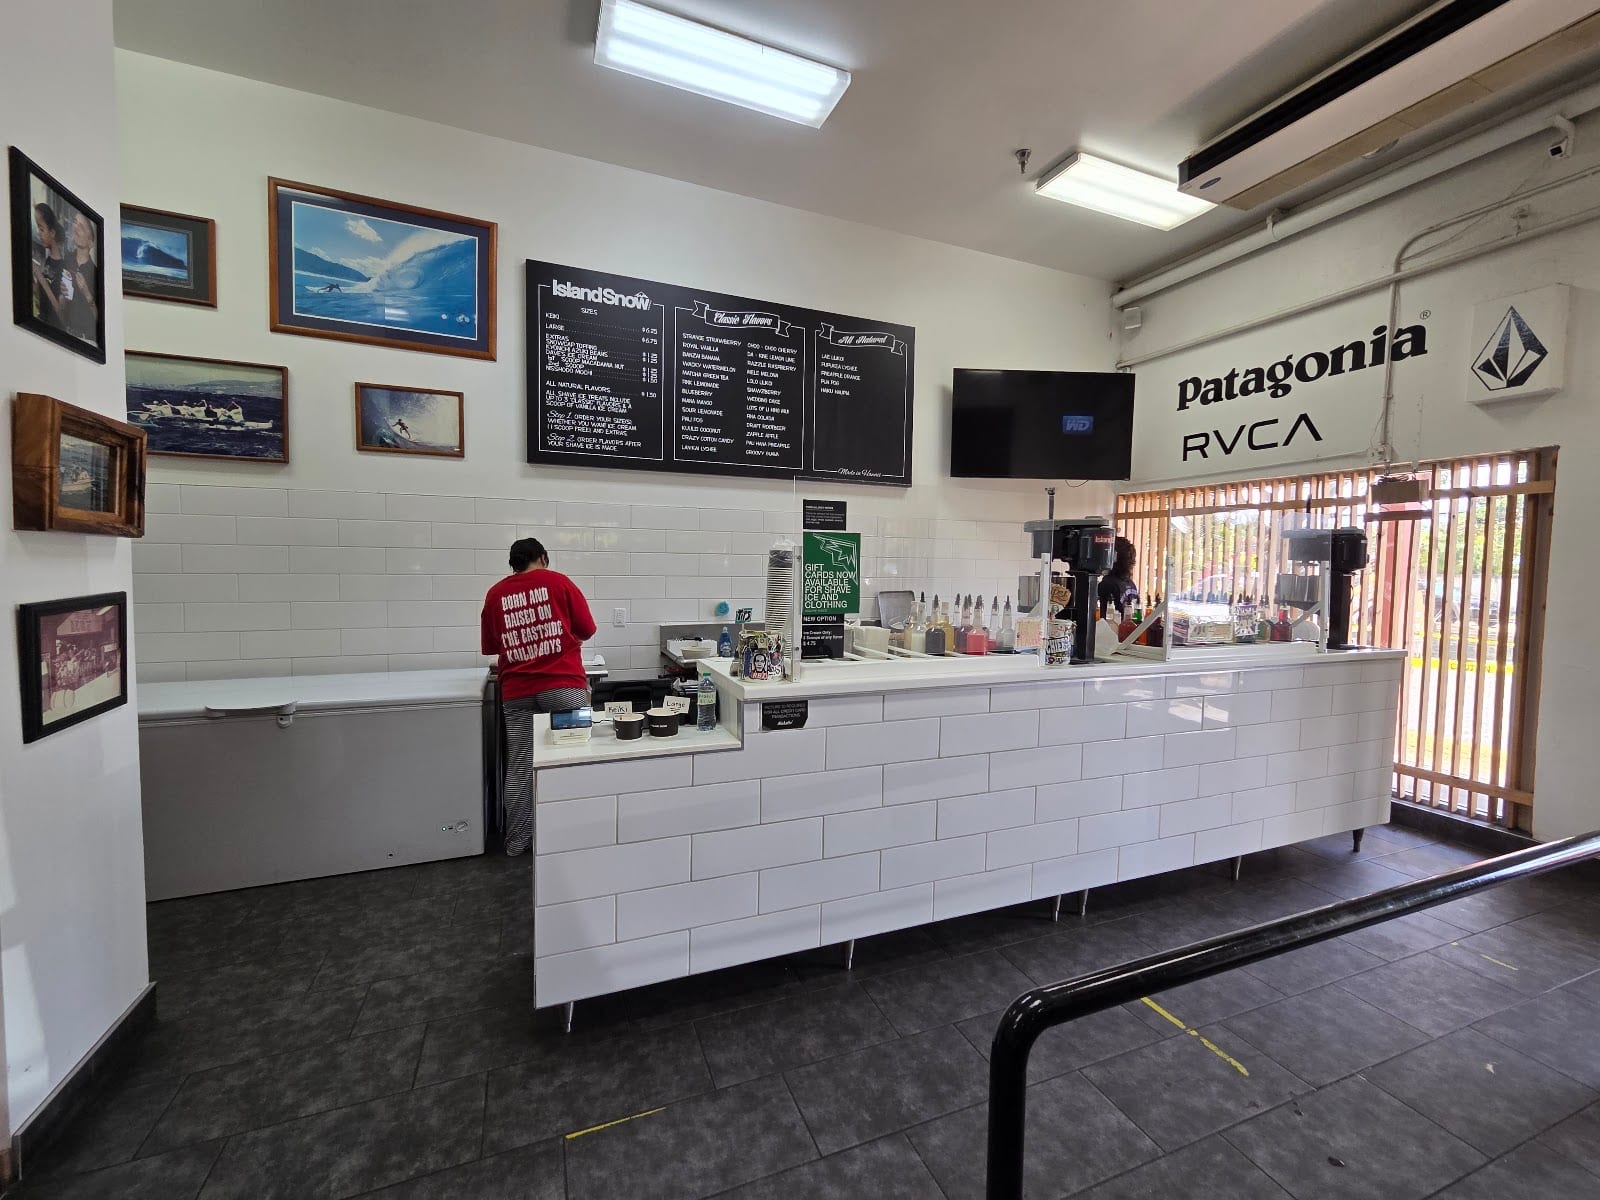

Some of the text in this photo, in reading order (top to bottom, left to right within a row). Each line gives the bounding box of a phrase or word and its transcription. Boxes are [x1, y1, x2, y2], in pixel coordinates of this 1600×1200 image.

[580, 306, 597, 315] SIZES
[714, 312, 772, 326] Classic Flavors
[545, 322, 564, 331] LARGE
[545, 332, 568, 341] EXTRAS
[856, 335, 888, 344] Natural
[545, 338, 575, 347] SNOWCAP
[1176, 325, 1428, 411] patagonia
[557, 381, 583, 389] NATURAL
[584, 384, 610, 392] FLAVORS
[546, 409, 565, 418] Step
[546, 432, 565, 441] Step
[1182, 413, 1323, 462] RVCA
[838, 468, 856, 476] Made
[805, 571, 834, 579] CARDS
[805, 578, 849, 586] AVAILABLE
[501, 586, 548, 611] BORN AND
[805, 600, 848, 608] CLOTHING
[504, 604, 552, 629] RAISED ON
[501, 620, 564, 648] THE EASTSIDE
[666, 700, 686, 708] Large
